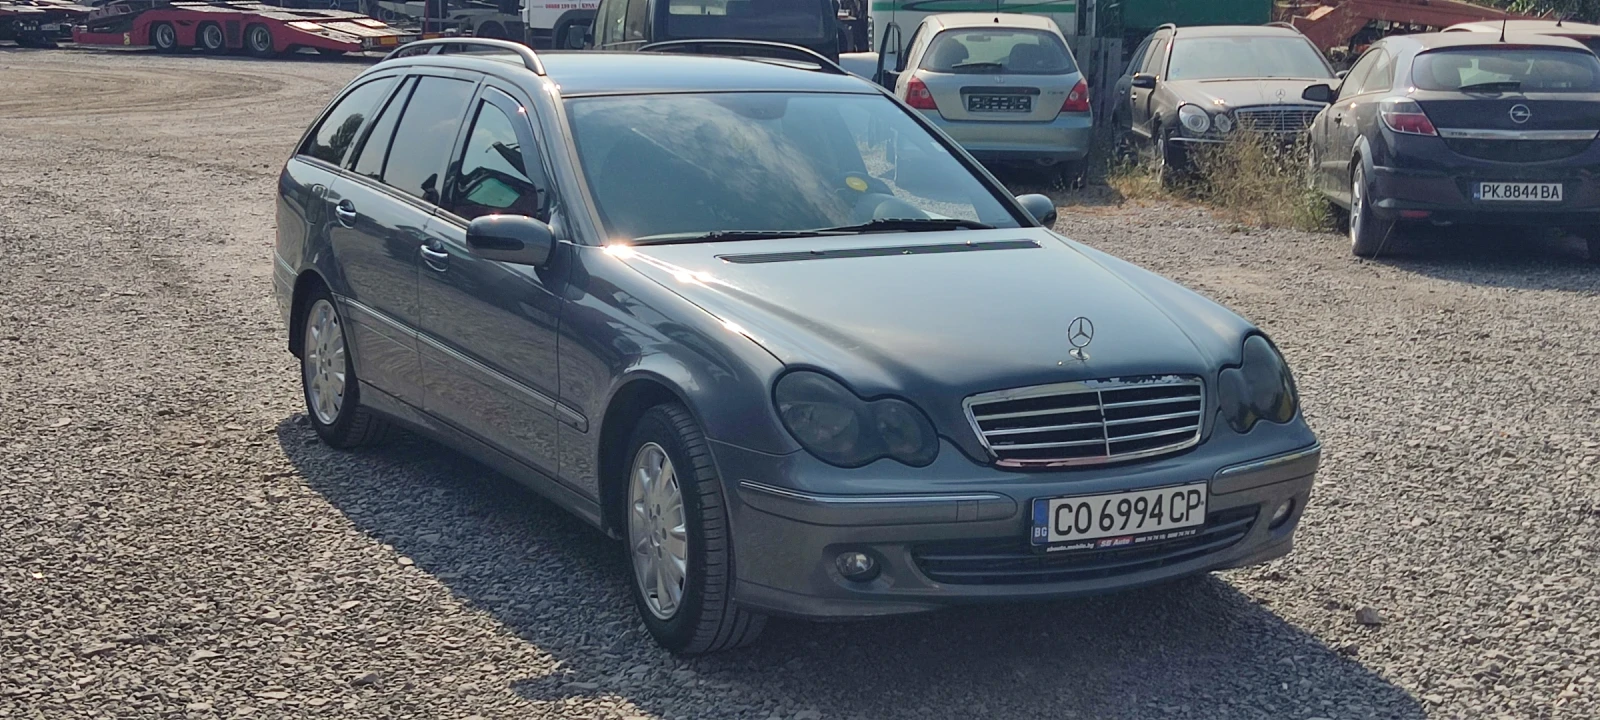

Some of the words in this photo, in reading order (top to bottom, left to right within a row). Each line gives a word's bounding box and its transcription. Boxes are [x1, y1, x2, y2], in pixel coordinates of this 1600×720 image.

[1054, 501, 1093, 536] CO
[1098, 493, 1164, 532] 6994
[1169, 489, 1201, 523] CP
[1034, 526, 1048, 537] BG
[1112, 538, 1130, 546] Auto
